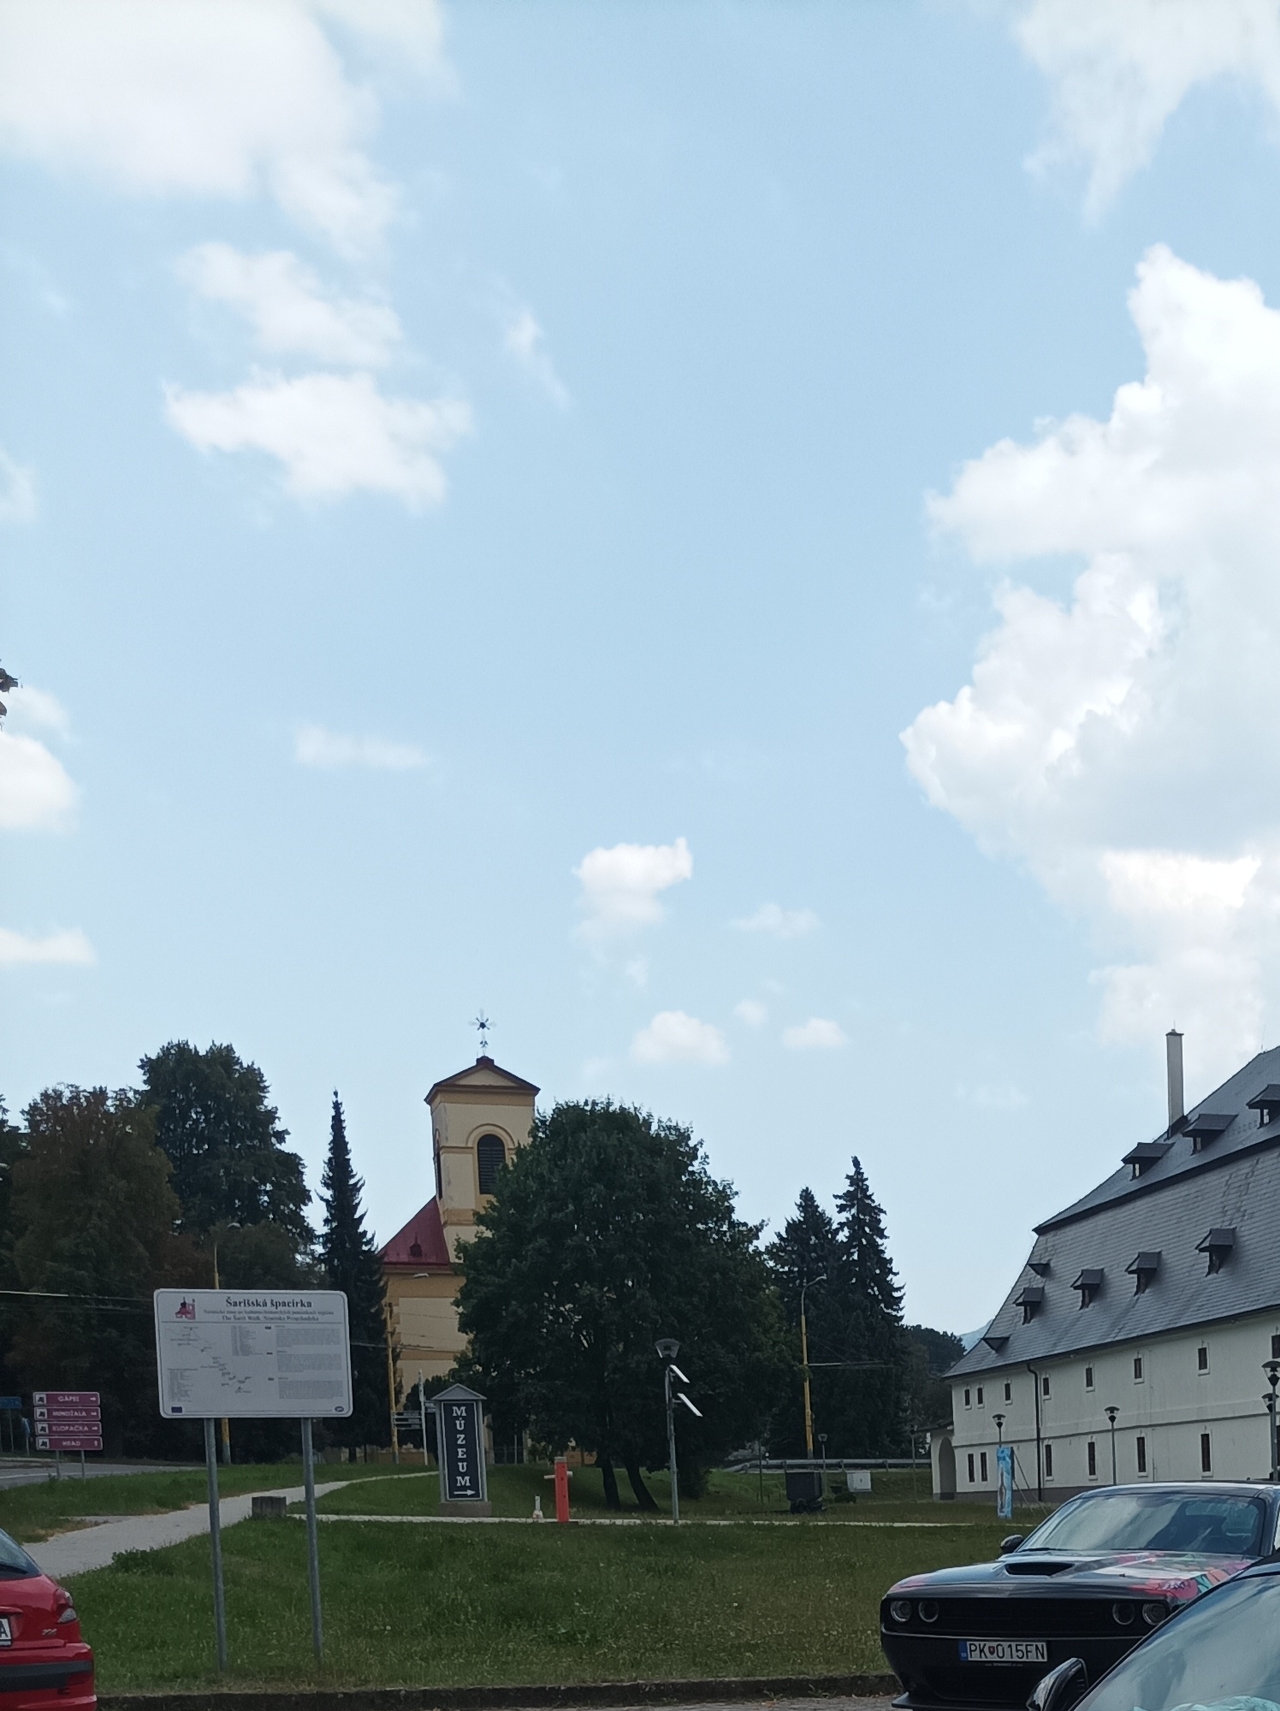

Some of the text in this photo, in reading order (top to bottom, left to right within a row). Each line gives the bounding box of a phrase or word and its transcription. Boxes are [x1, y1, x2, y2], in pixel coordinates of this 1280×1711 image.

[225, 1296, 313, 1310] Šarišská špacírka
[452, 1406, 471, 1487] MÚZEUM
